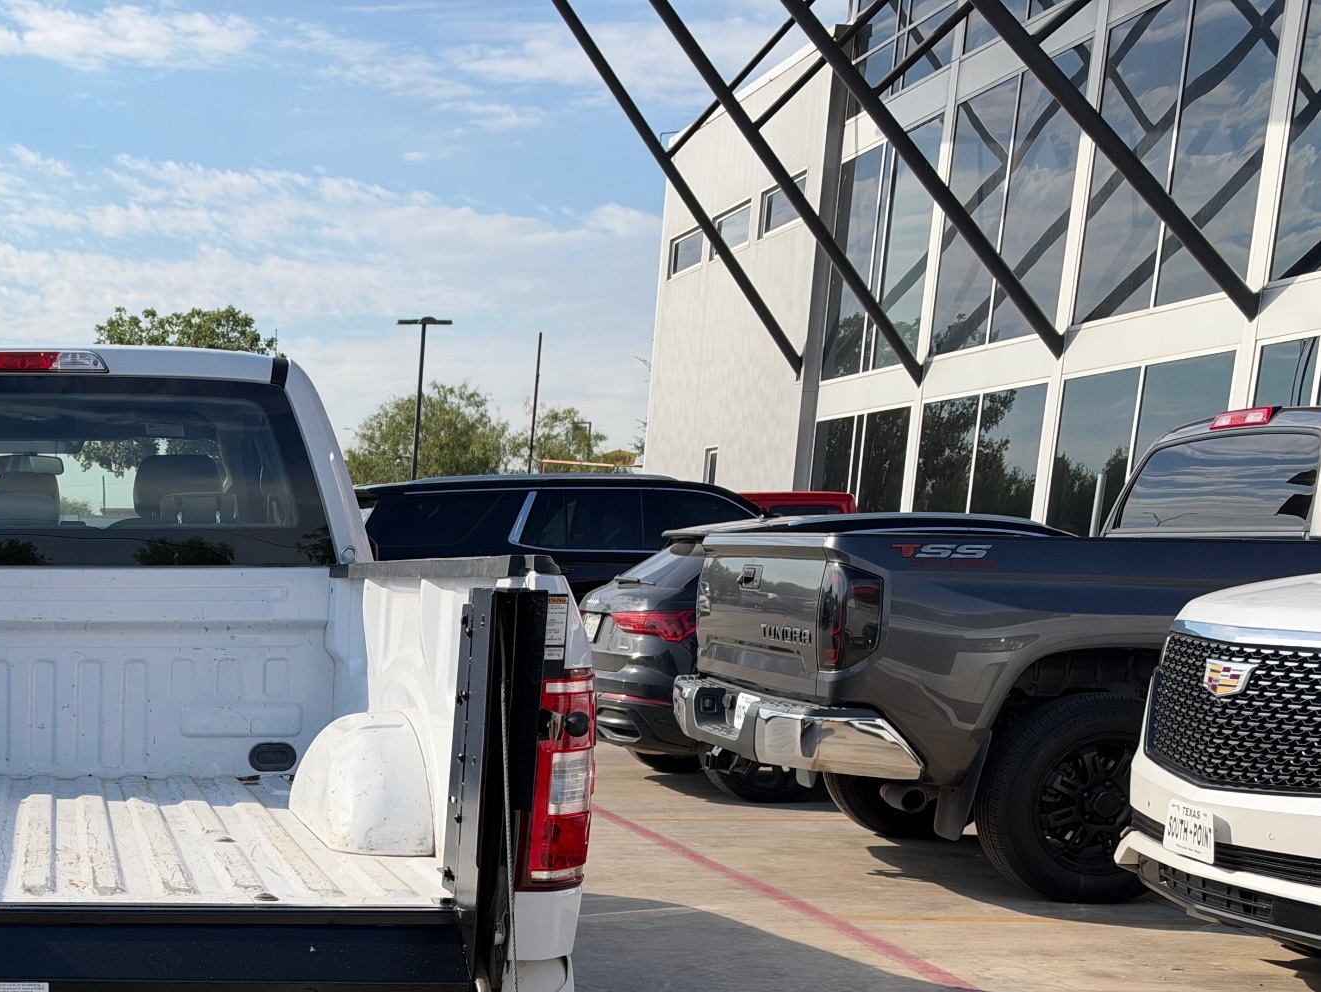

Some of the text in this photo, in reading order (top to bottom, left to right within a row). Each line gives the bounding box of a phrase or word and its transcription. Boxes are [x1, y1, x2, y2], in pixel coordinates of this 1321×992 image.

[891, 543, 994, 559] TSS
[760, 623, 812, 647] TUNDRA
[1182, 806, 1201, 820] TEXAS
